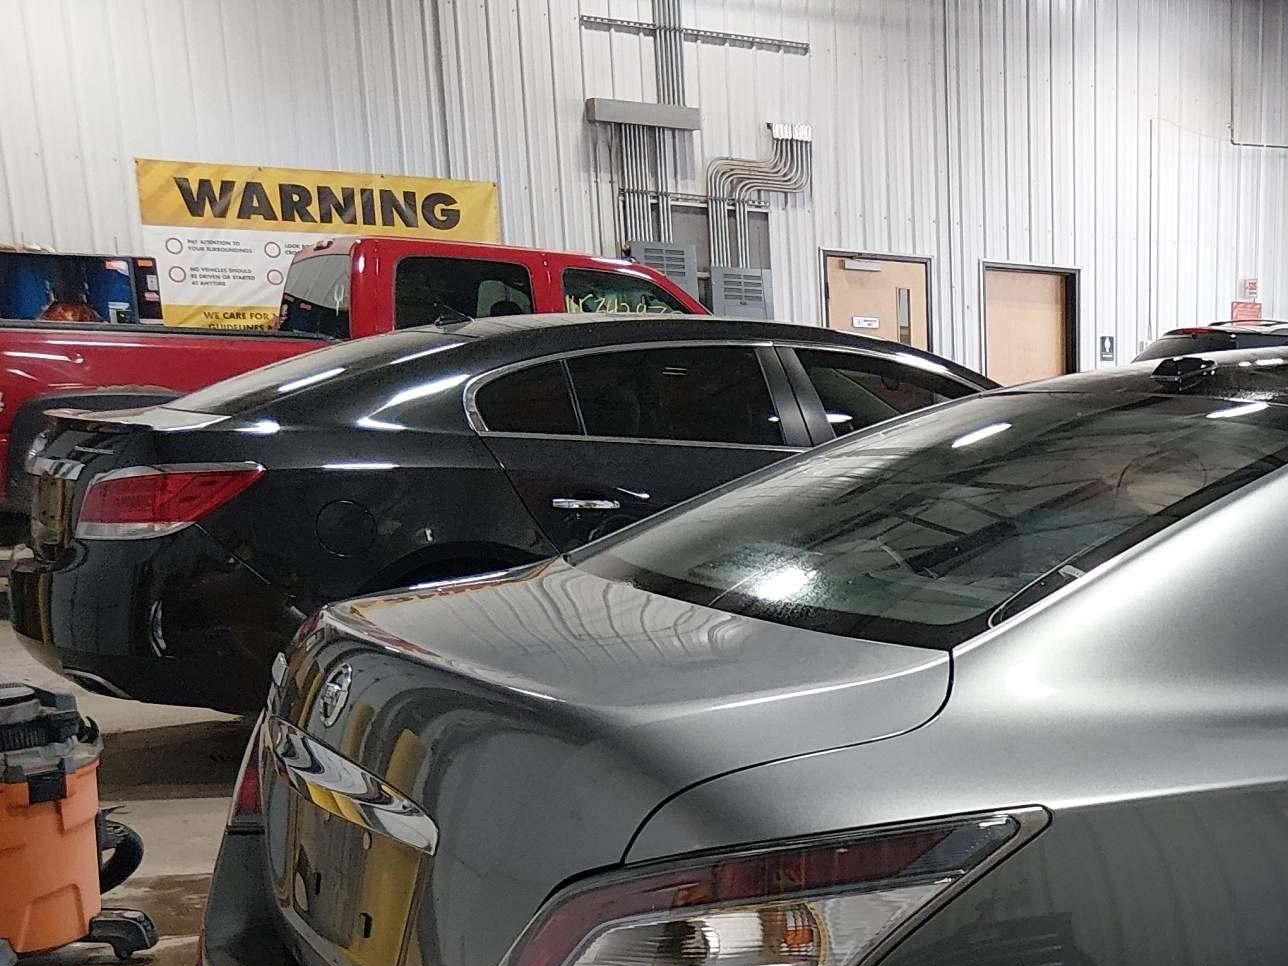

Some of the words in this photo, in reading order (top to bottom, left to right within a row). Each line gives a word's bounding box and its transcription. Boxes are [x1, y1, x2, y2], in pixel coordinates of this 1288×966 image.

[173, 177, 461, 230] WARNING
[223, 312, 247, 320] CARE
[250, 312, 269, 320] FOR
